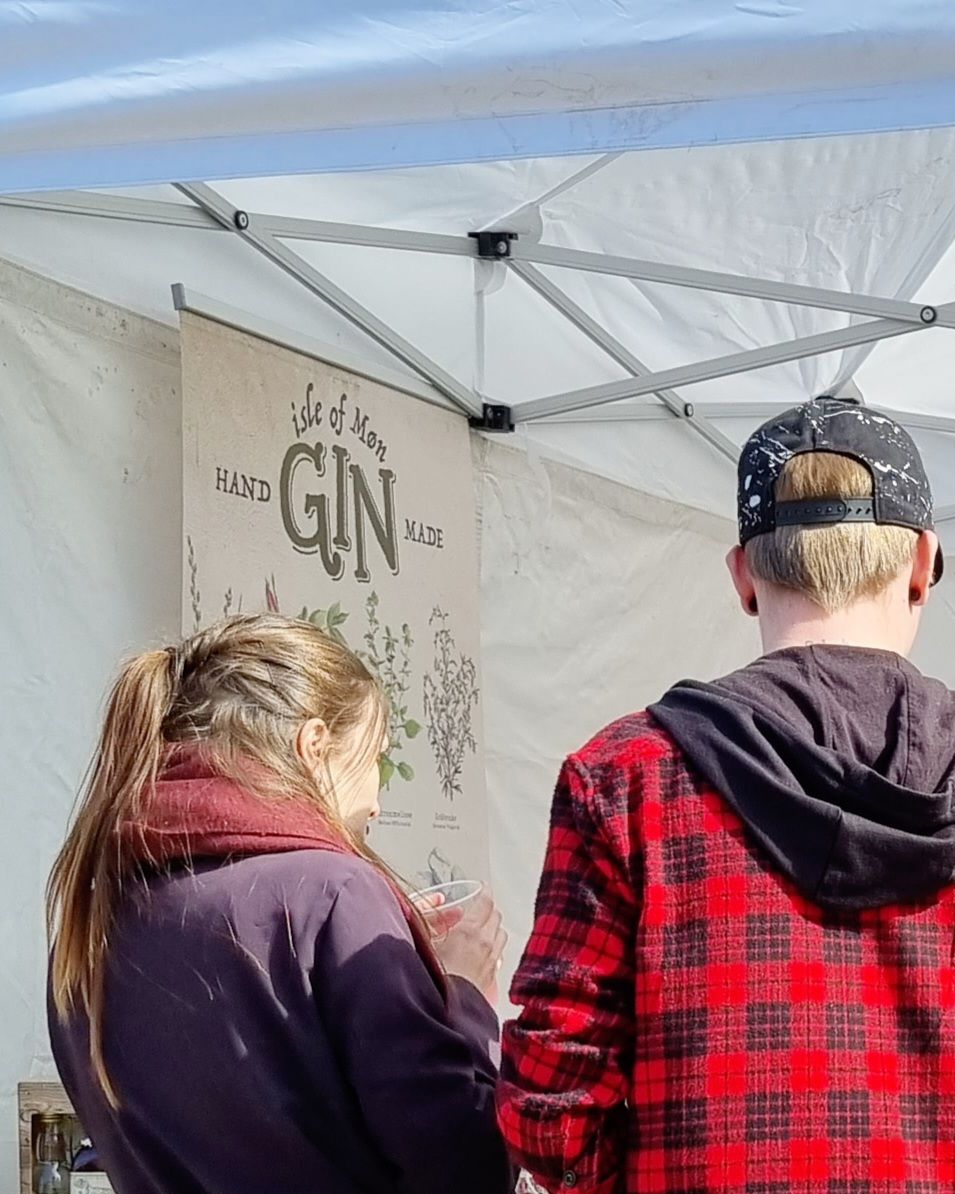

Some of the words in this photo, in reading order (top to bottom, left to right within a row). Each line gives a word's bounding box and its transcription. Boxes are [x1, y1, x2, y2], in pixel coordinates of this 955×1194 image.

[292, 383, 322, 438] isle
[329, 393, 347, 435] of
[349, 407, 389, 463] Møn
[215, 467, 271, 502] HAND
[279, 442, 400, 581] GIN
[404, 518, 444, 549] MADE
